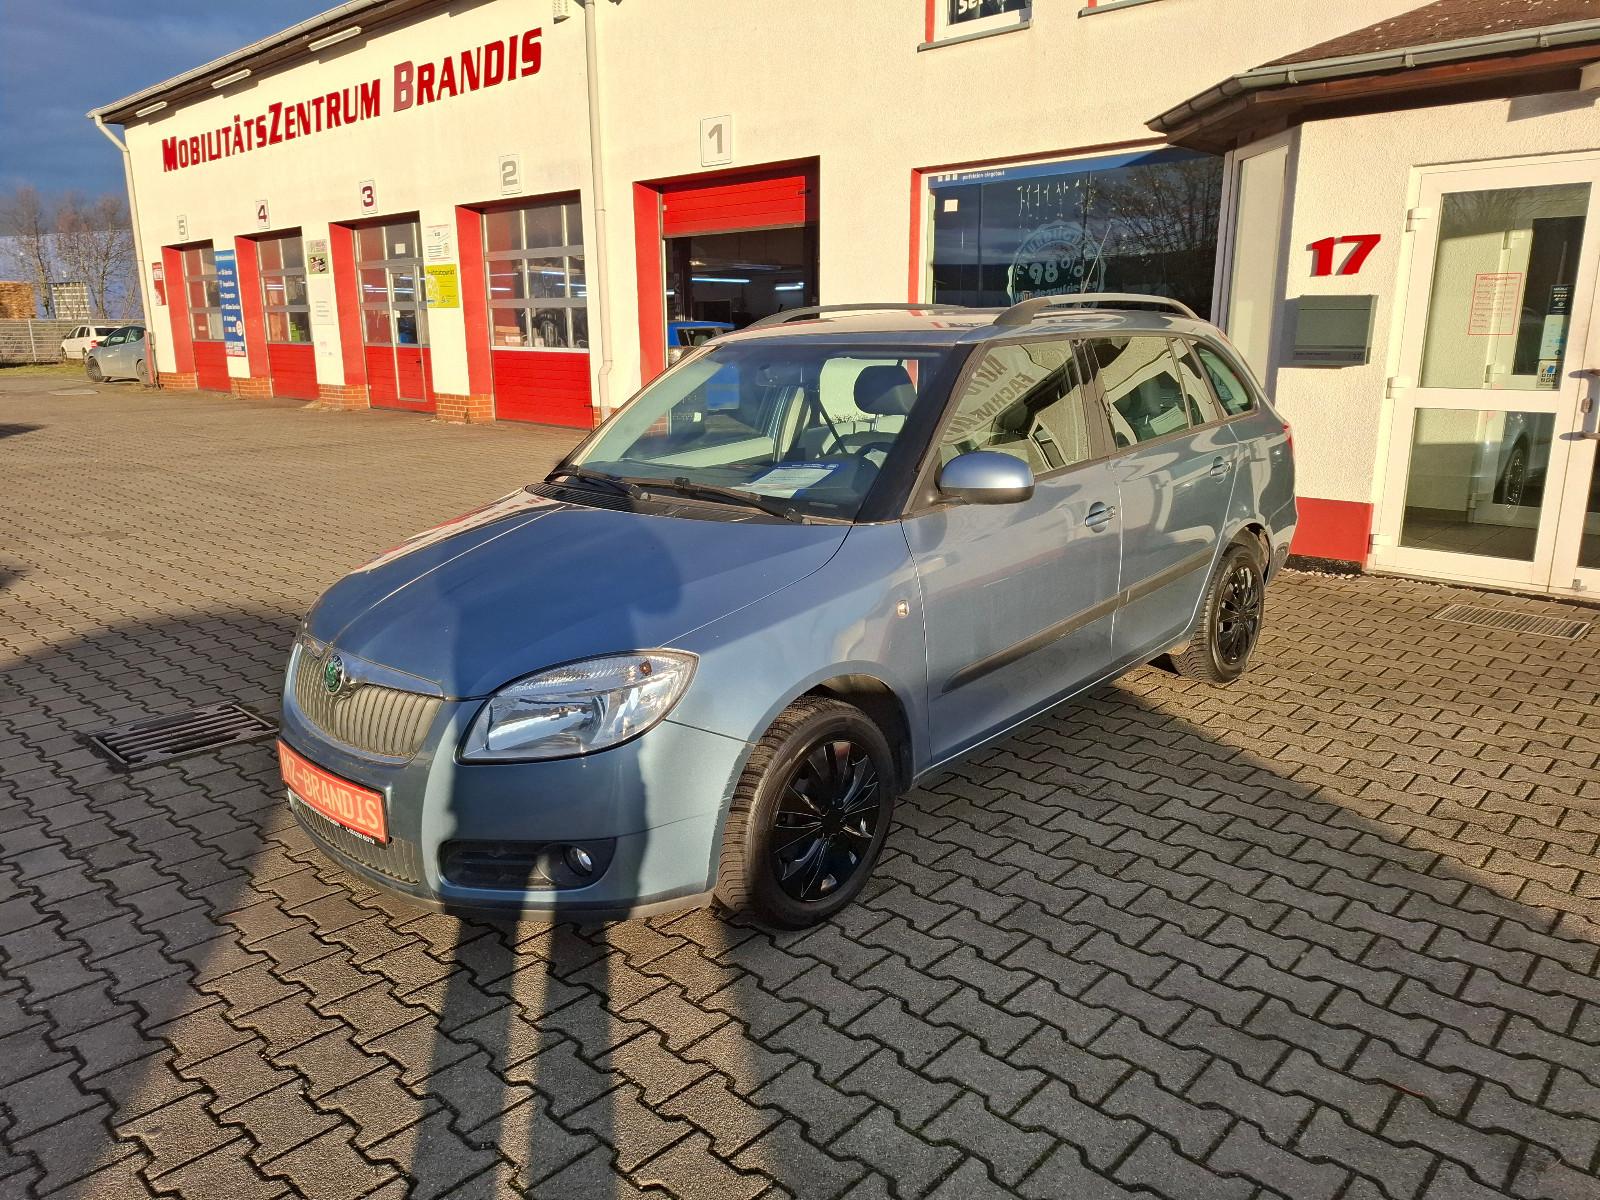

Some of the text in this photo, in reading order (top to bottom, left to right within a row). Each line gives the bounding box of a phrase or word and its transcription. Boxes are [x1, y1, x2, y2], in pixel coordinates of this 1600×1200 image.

[393, 27, 542, 113] BRANDIS
[708, 123, 723, 154] 1
[502, 160, 518, 187] 2
[362, 185, 374, 207] 3
[178, 219, 186, 236] 5
[257, 204, 268, 223] 4
[1305, 233, 1382, 278] 17
[1028, 256, 1085, 285] 98%
[281, 750, 380, 831] MZ-BRANDIS
